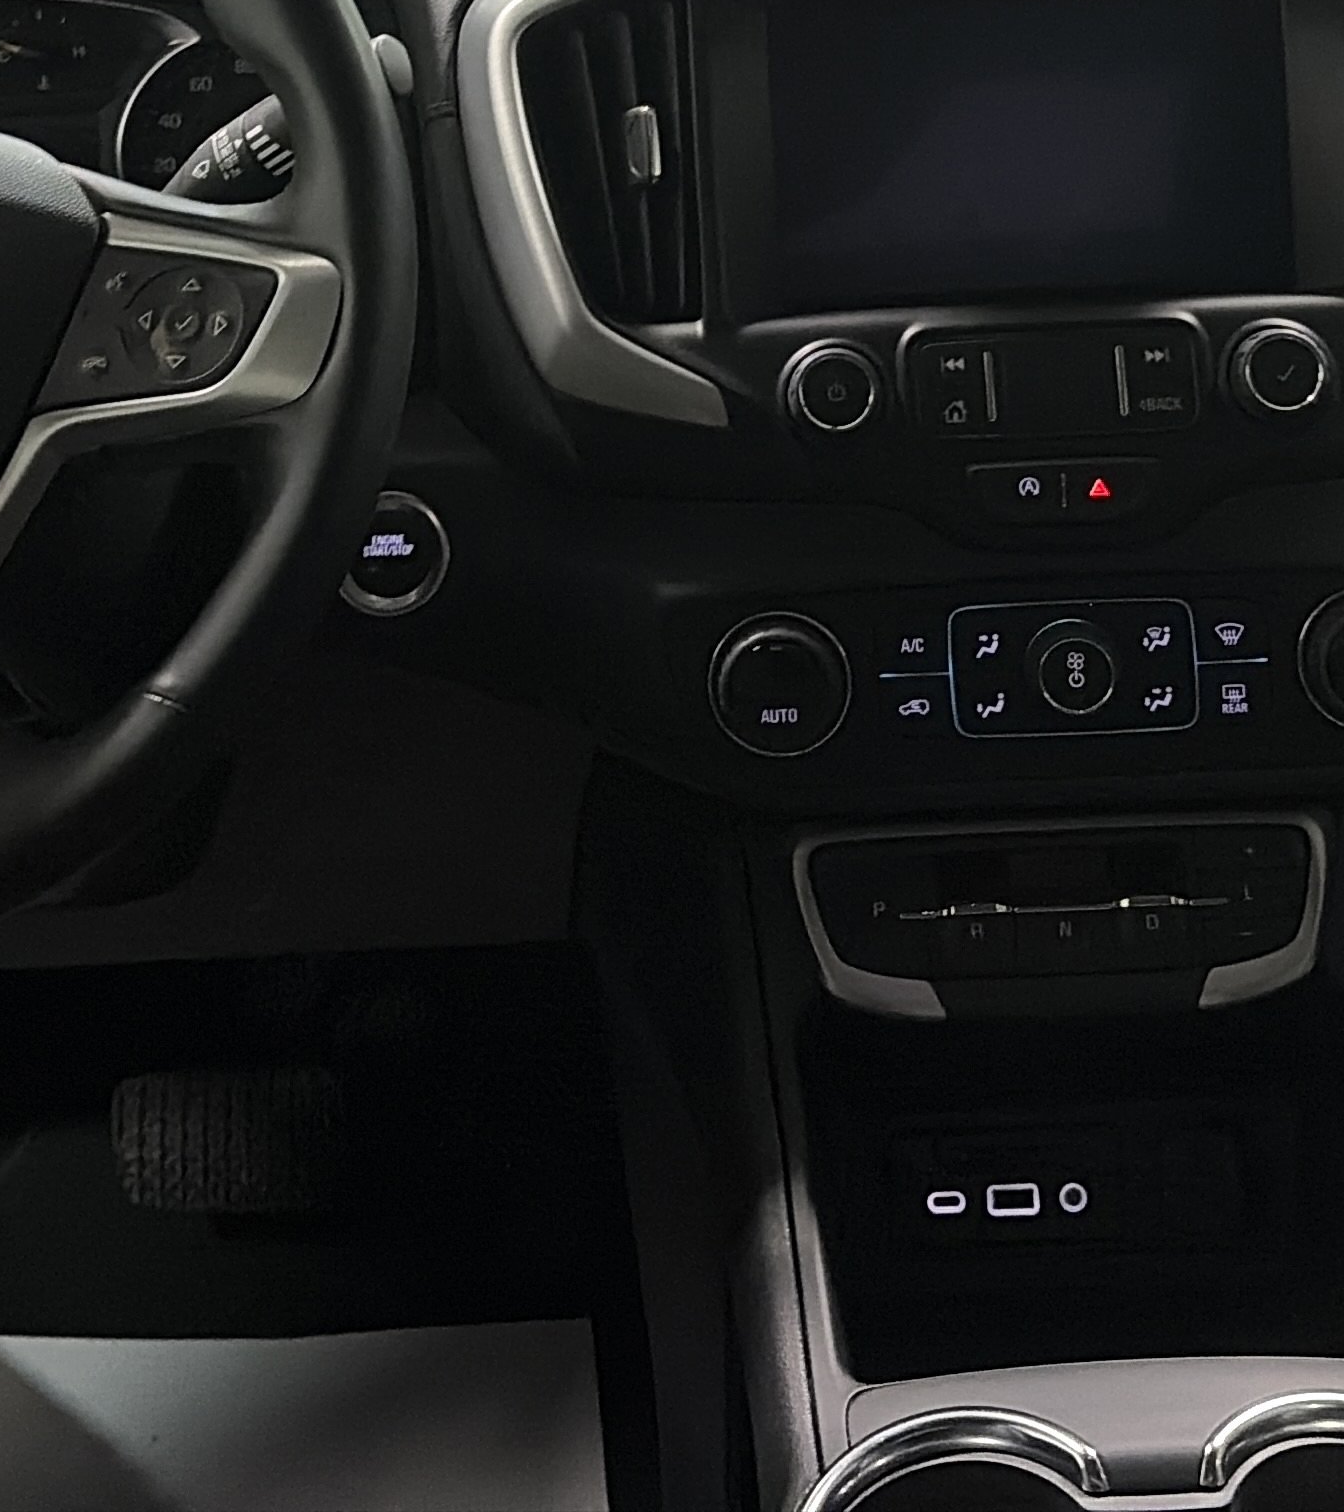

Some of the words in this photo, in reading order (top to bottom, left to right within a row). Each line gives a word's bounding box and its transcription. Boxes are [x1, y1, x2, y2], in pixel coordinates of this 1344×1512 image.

[1147, 397, 1184, 412] BACK
[900, 637, 925, 654] A/C
[760, 707, 799, 724] AUTO
[1221, 702, 1249, 714] REAR
[872, 901, 887, 918] P
[1059, 920, 1073, 938] N
[1146, 913, 1159, 930] D
